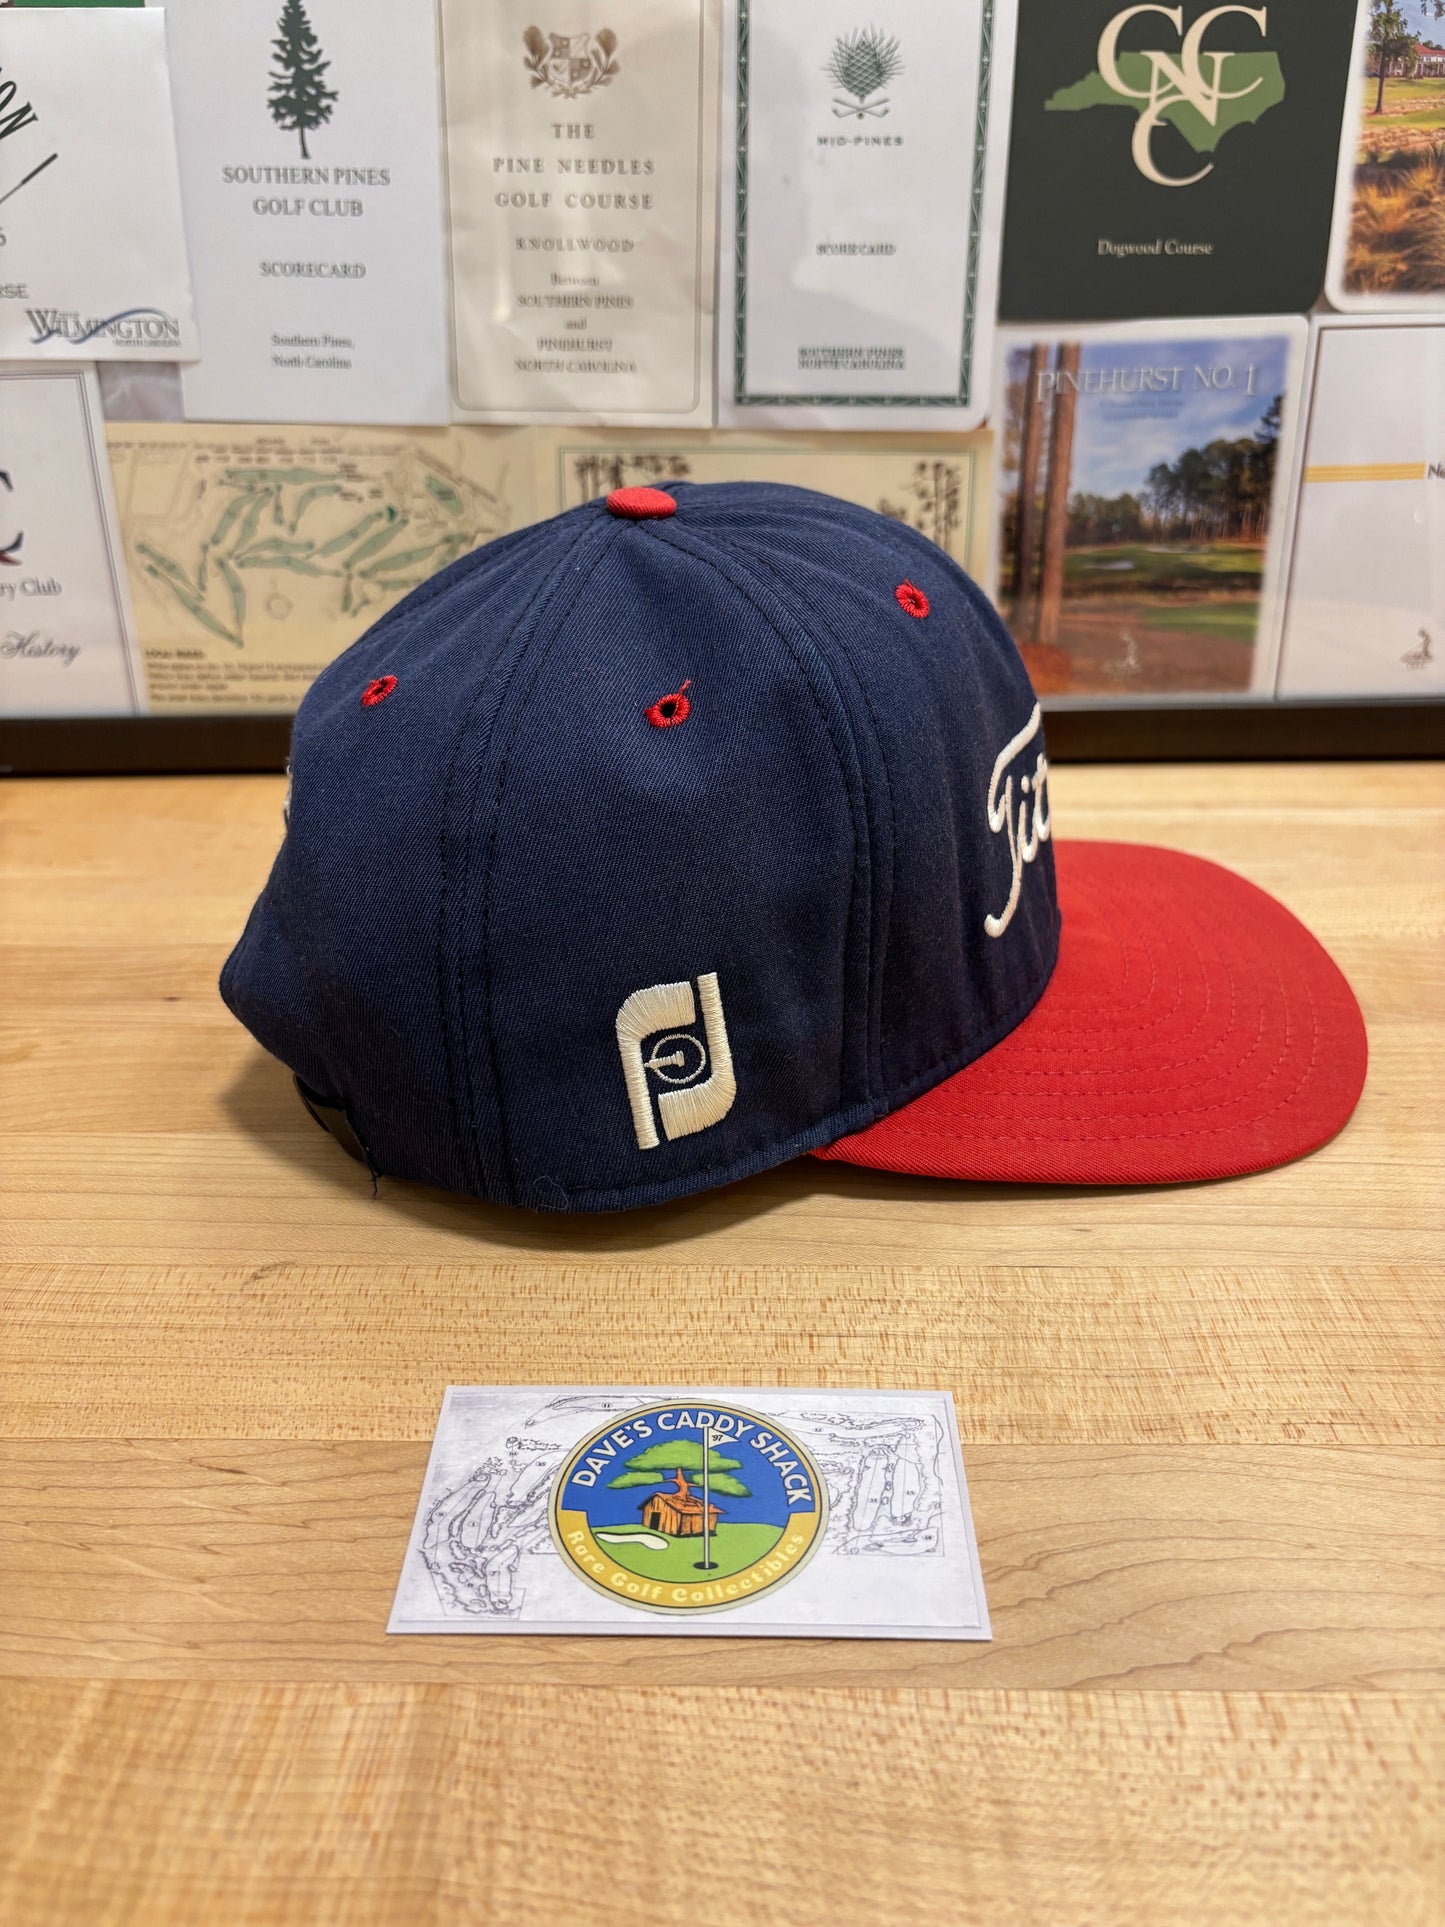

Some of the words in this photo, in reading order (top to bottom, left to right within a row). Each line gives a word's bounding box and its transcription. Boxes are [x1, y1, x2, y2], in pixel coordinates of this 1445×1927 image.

[552, 123, 595, 139] THE
[816, 135, 904, 146] MID-PINES
[222, 165, 330, 185] SOUTHERN
[333, 167, 391, 186] PINES
[493, 157, 545, 173] PINE
[558, 158, 655, 175] NEEDLES
[252, 198, 305, 216] GOLF
[308, 199, 364, 217] CLUB
[494, 192, 552, 208] GOLF
[564, 193, 654, 209] COURSE
[515, 238, 635, 253] KNOLLWOOD
[1097, 238, 1162, 258] Dogwood
[1164, 238, 1214, 255] Course
[258, 261, 367, 279] SCORECARD
[25, 308, 181, 340] WILMINGTON
[1036, 366, 1184, 402] PINEHURST
[20, 576, 63, 597] Club
[0, 630, 82, 668] History
[571, 1418, 653, 1488] DAVE'S
[656, 1411, 755, 1438] CADDY
[749, 1432, 812, 1506] SHACK
[567, 1530, 606, 1574] Rare
[610, 1572, 664, 1601] Golf
[671, 1533, 805, 1602] Collectibles
